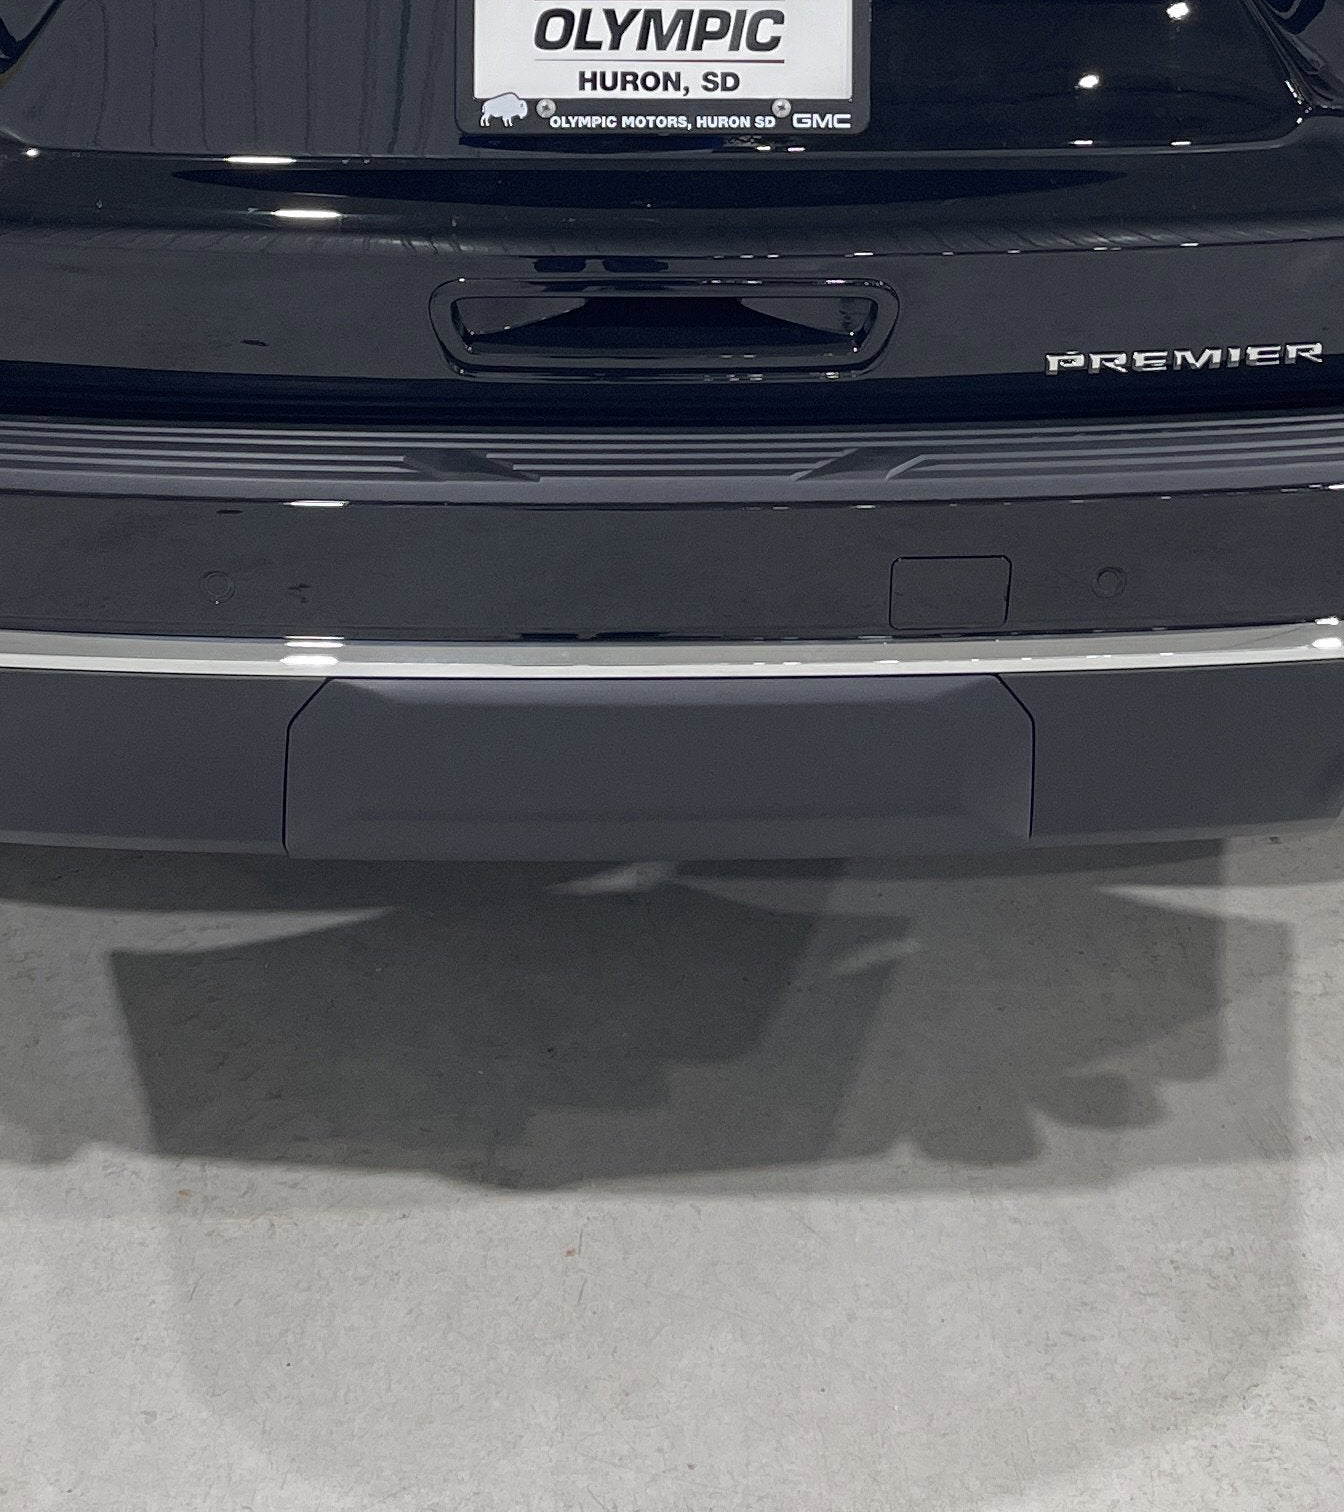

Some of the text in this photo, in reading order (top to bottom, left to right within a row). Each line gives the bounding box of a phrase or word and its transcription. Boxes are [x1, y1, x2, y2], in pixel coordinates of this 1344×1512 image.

[533, 7, 785, 52] OLYMPIC
[578, 70, 741, 96] HURON, SD
[549, 115, 776, 132] OLYMPIC MOTORS, HURON SD
[792, 113, 852, 129] GMC
[1044, 341, 1324, 376] PREMIER
